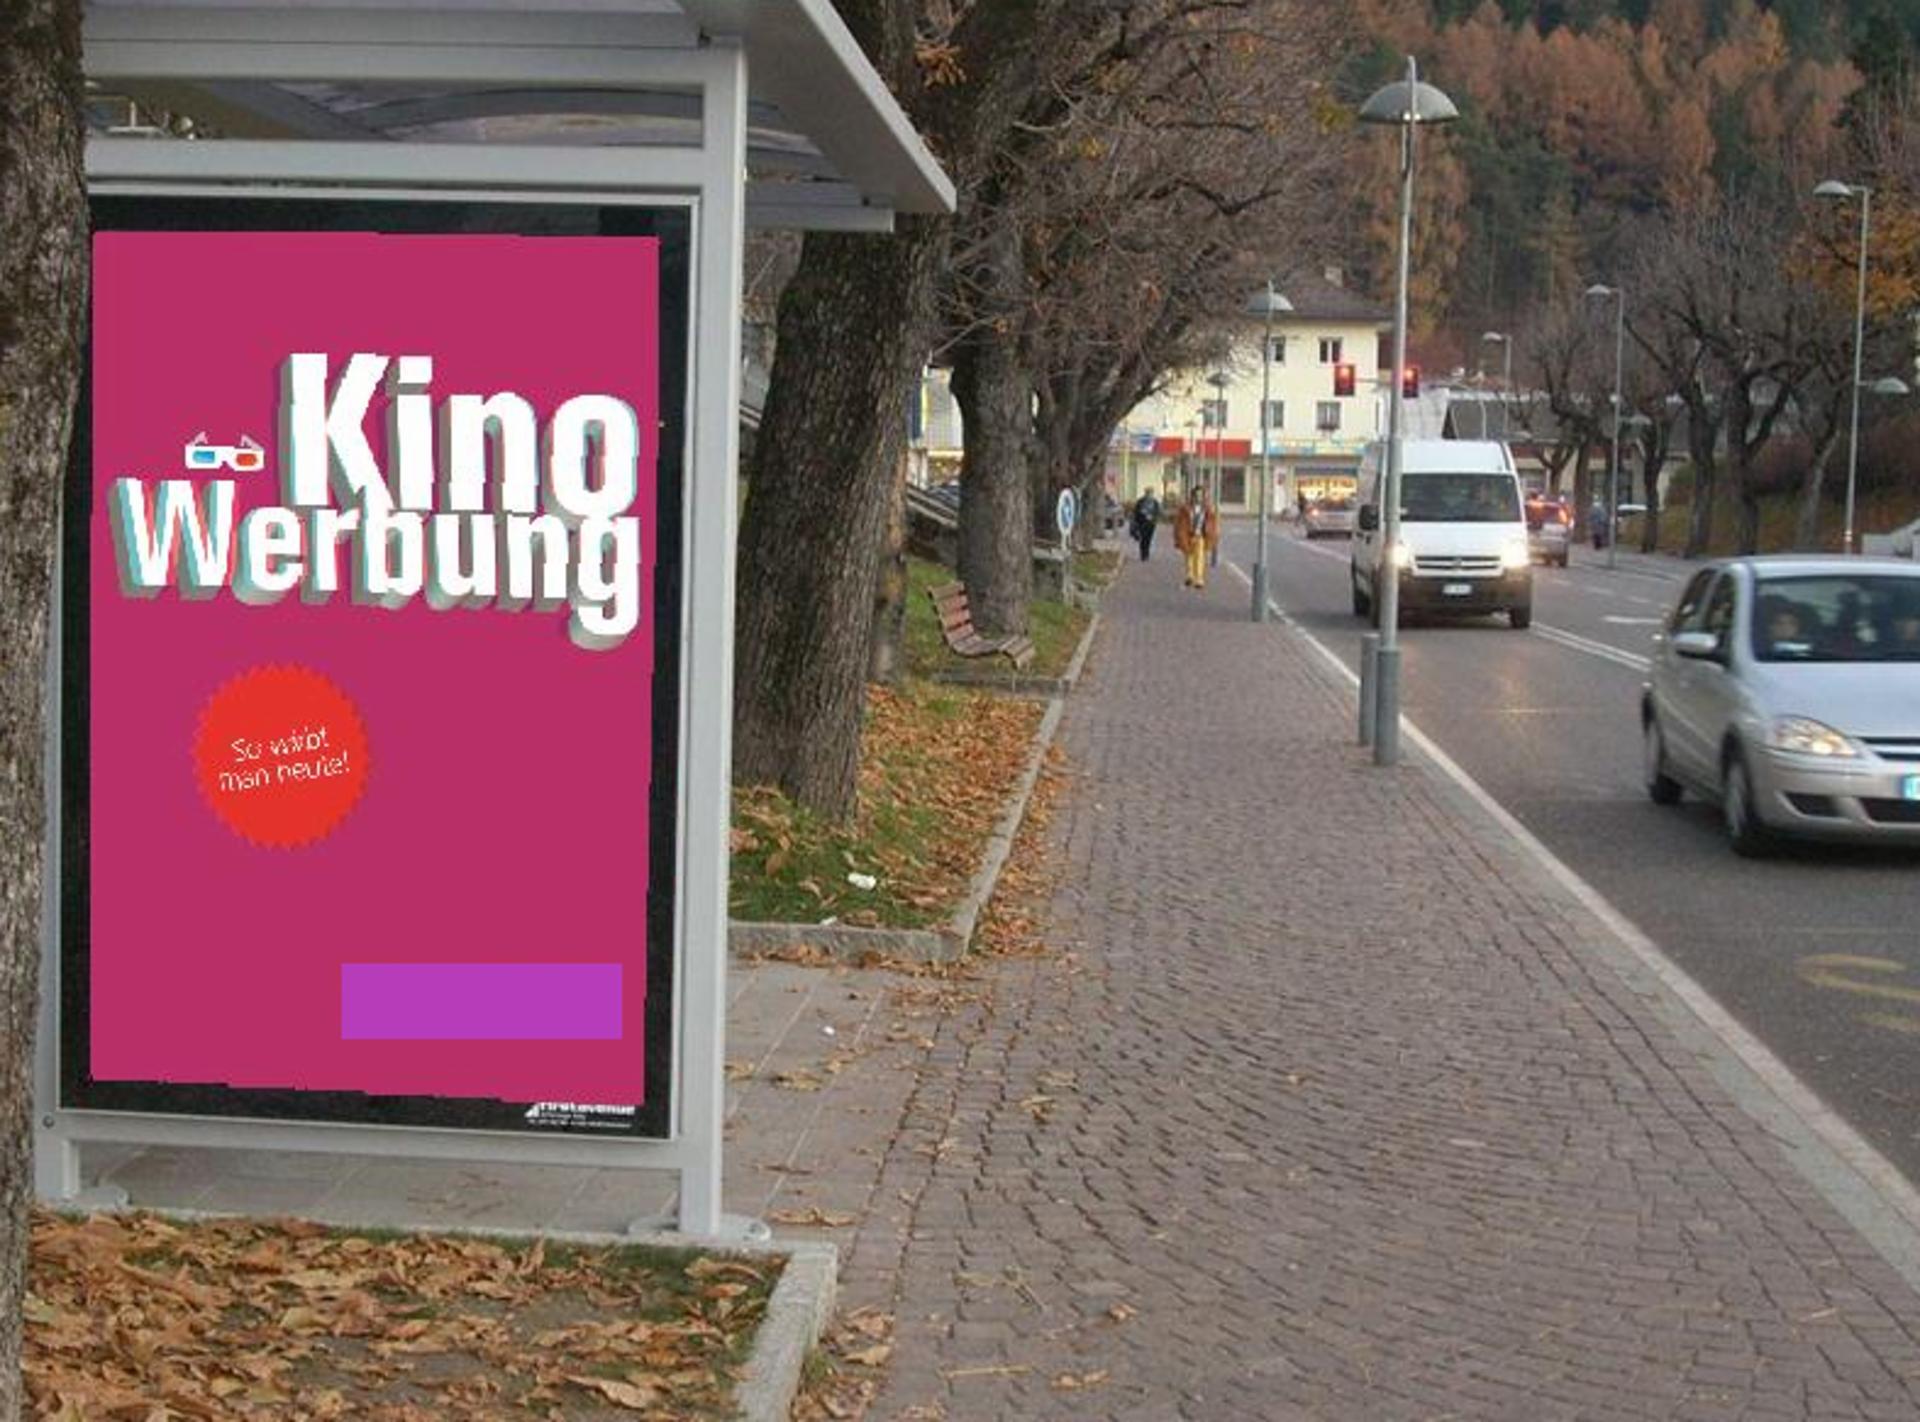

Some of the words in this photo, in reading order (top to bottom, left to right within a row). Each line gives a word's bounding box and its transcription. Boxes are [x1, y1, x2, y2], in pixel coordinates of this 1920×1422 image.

[277, 352, 639, 517] Kino
[111, 477, 641, 645] Werbung
[219, 767, 270, 792] man
[229, 737, 263, 763] So
